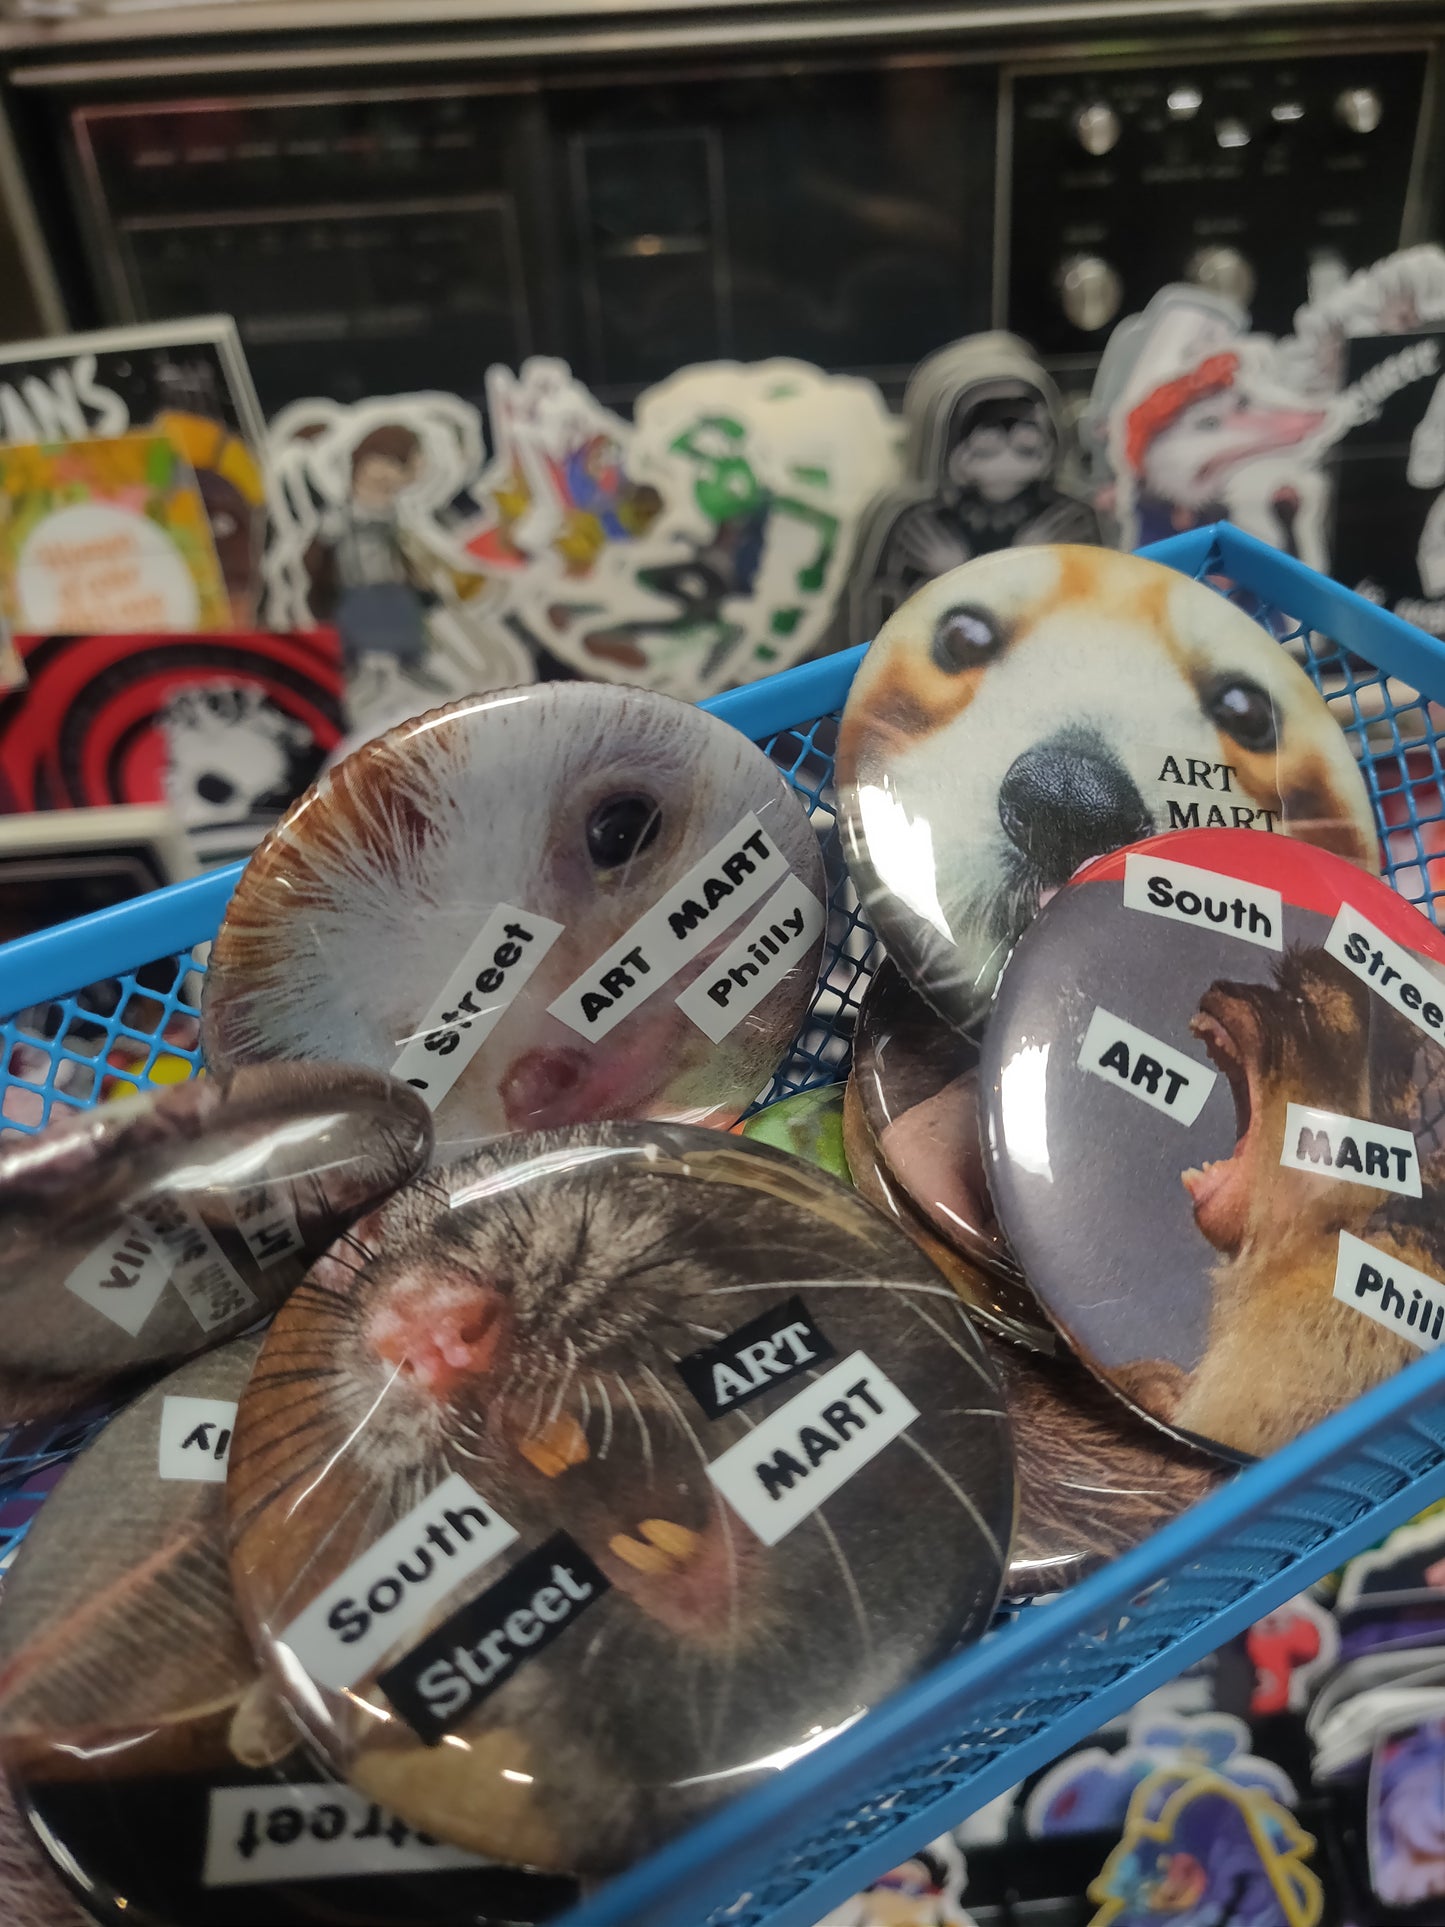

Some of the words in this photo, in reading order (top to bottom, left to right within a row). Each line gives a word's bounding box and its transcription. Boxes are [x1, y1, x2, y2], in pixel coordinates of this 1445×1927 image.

[1157, 755, 1238, 793] ART
[1166, 800, 1281, 833] MART
[580, 946, 651, 1023] ART
[668, 829, 771, 940] MART
[1147, 876, 1272, 938] South
[424, 923, 534, 1057] Street
[707, 907, 806, 1008] Philly
[1344, 932, 1445, 1038] Stree
[1099, 1040, 1190, 1105] ART
[1296, 1126, 1413, 1183] MART
[1354, 1262, 1445, 1341] Phill
[712, 1321, 818, 1407] ART
[755, 1378, 884, 1502] MART
[327, 1506, 490, 1644] South
[416, 1563, 595, 1719] Street
[235, 1801, 440, 1860] treet
